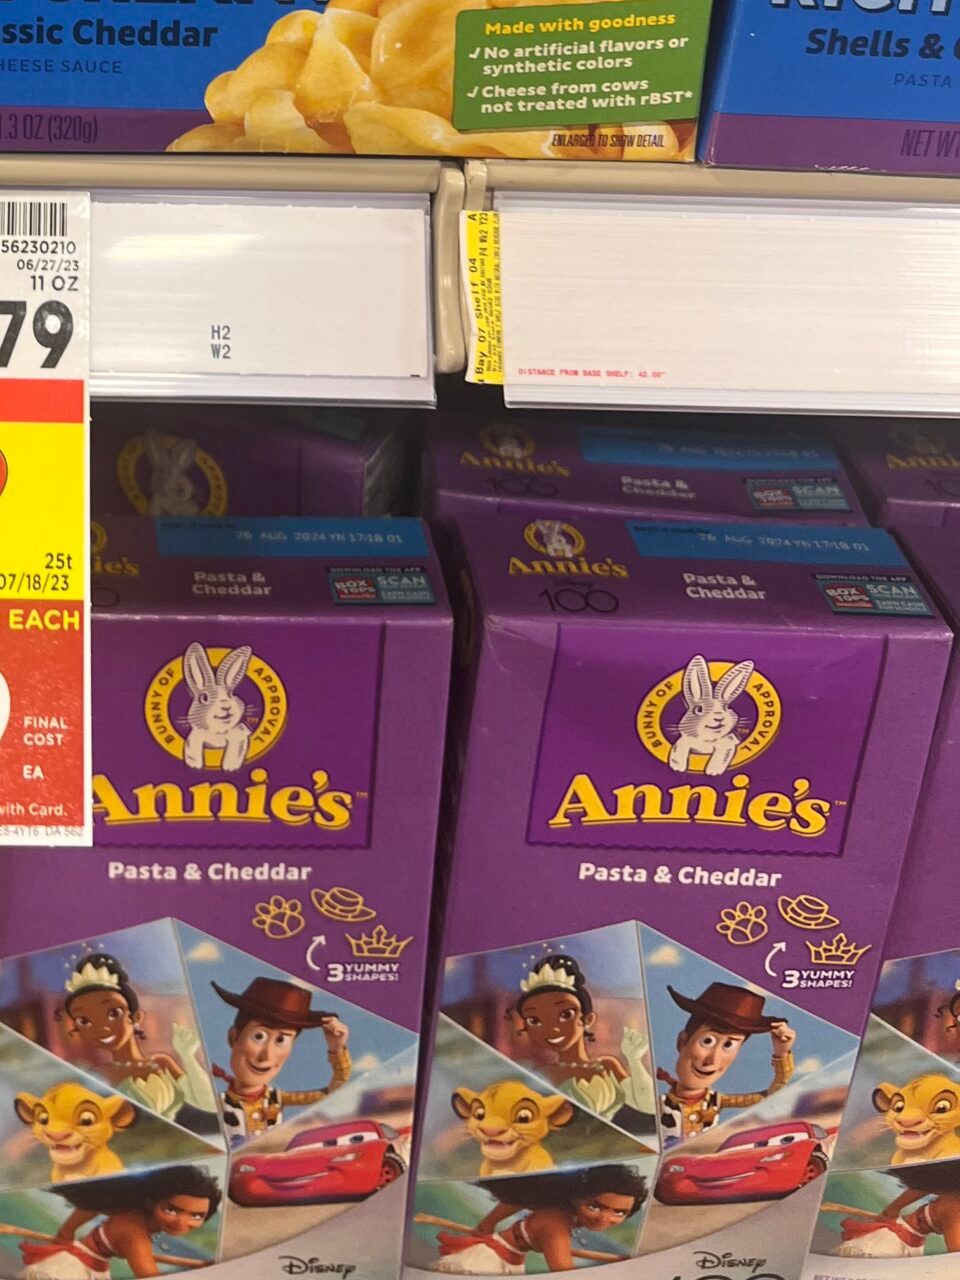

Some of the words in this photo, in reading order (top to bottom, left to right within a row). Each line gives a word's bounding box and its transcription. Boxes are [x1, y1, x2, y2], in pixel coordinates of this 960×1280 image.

[73, 18, 218, 48] Cheddar
[485, 21, 534, 35] Made
[539, 18, 584, 33] with
[589, 13, 676, 33] goodness
[484, 46, 510, 59] No
[514, 41, 595, 58] artificial
[599, 37, 664, 54] flavors
[668, 36, 688, 49] or
[806, 28, 911, 58] Shells
[60, 58, 123, 74] SAUCE
[483, 58, 571, 77] synthetic
[576, 56, 633, 70] colors
[481, 81, 546, 98] Cheese
[551, 78, 597, 95] from
[601, 80, 649, 93] cows
[481, 99, 513, 114] not
[517, 96, 587, 112] treated
[592, 94, 635, 109] with
[24, 114, 44, 143] OZ
[47, 114, 98, 145] (320g)
[552, 133, 595, 147] ENLARGED
[597, 134, 609, 147] TO
[610, 134, 635, 147] SHOW
[637, 134, 665, 148] DETAIL
[16, 258, 79, 272] 06/27/23
[469, 258, 477, 273] 04
[30, 275, 45, 291] 11
[52, 275, 79, 291] OZ
[471, 282, 481, 319] Shelf
[210, 324, 232, 341] H2
[478, 329, 486, 342] 07
[210, 343, 232, 360] W2
[475, 350, 487, 375] Bay
[518, 368, 555, 376] DISTANCE
[44, 553, 72, 570] 25t
[9, 609, 79, 631] EACH
[24, 716, 68, 729] FINAL
[24, 733, 63, 746] COST
[22, 765, 44, 779] EA
[93, 768, 353, 830] Annie's
[548, 772, 832, 838] Annie's
[28, 803, 68, 817] Card.
[108, 861, 176, 881] Pasta
[184, 862, 201, 881] &
[208, 861, 312, 883] Cheddar
[578, 862, 648, 883] Pasta
[654, 865, 672, 884] &
[677, 866, 782, 887] Cheddar
[782, 970, 800, 989] 3
[800, 970, 855, 981] YUMMY
[799, 979, 853, 989] SHAPES!
